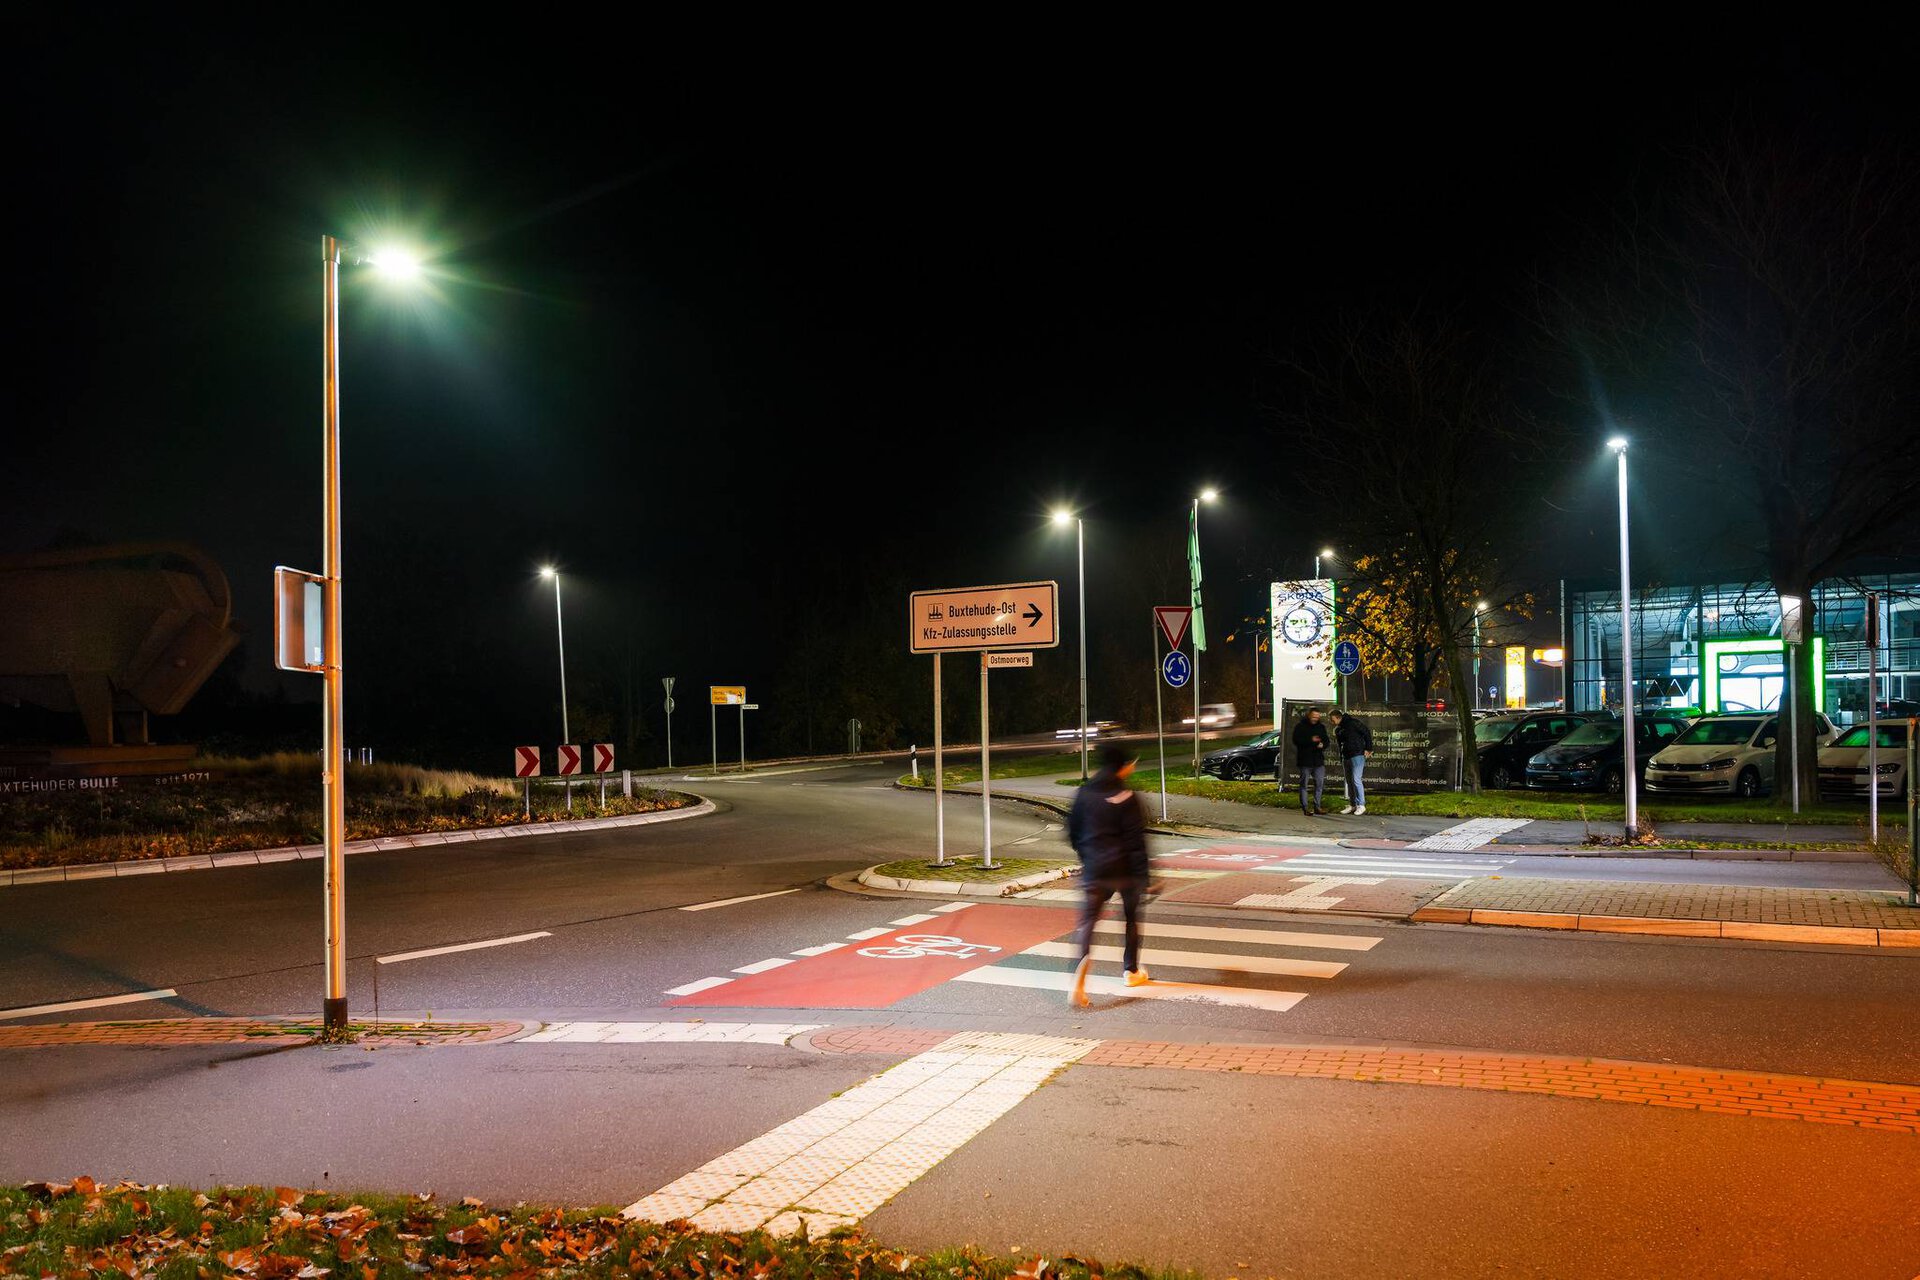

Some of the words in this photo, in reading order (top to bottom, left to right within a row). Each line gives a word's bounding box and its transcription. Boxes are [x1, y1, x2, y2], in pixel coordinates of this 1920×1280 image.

[949, 602, 1016, 618] Buxtehude-Ost
[923, 623, 1017, 640] Kfz-Zulassungsstelle
[990, 655, 1030, 666] Ostmoorweg
[0, 779, 75, 793] XTEHUDER
[182, 772, 210, 782] 1971
